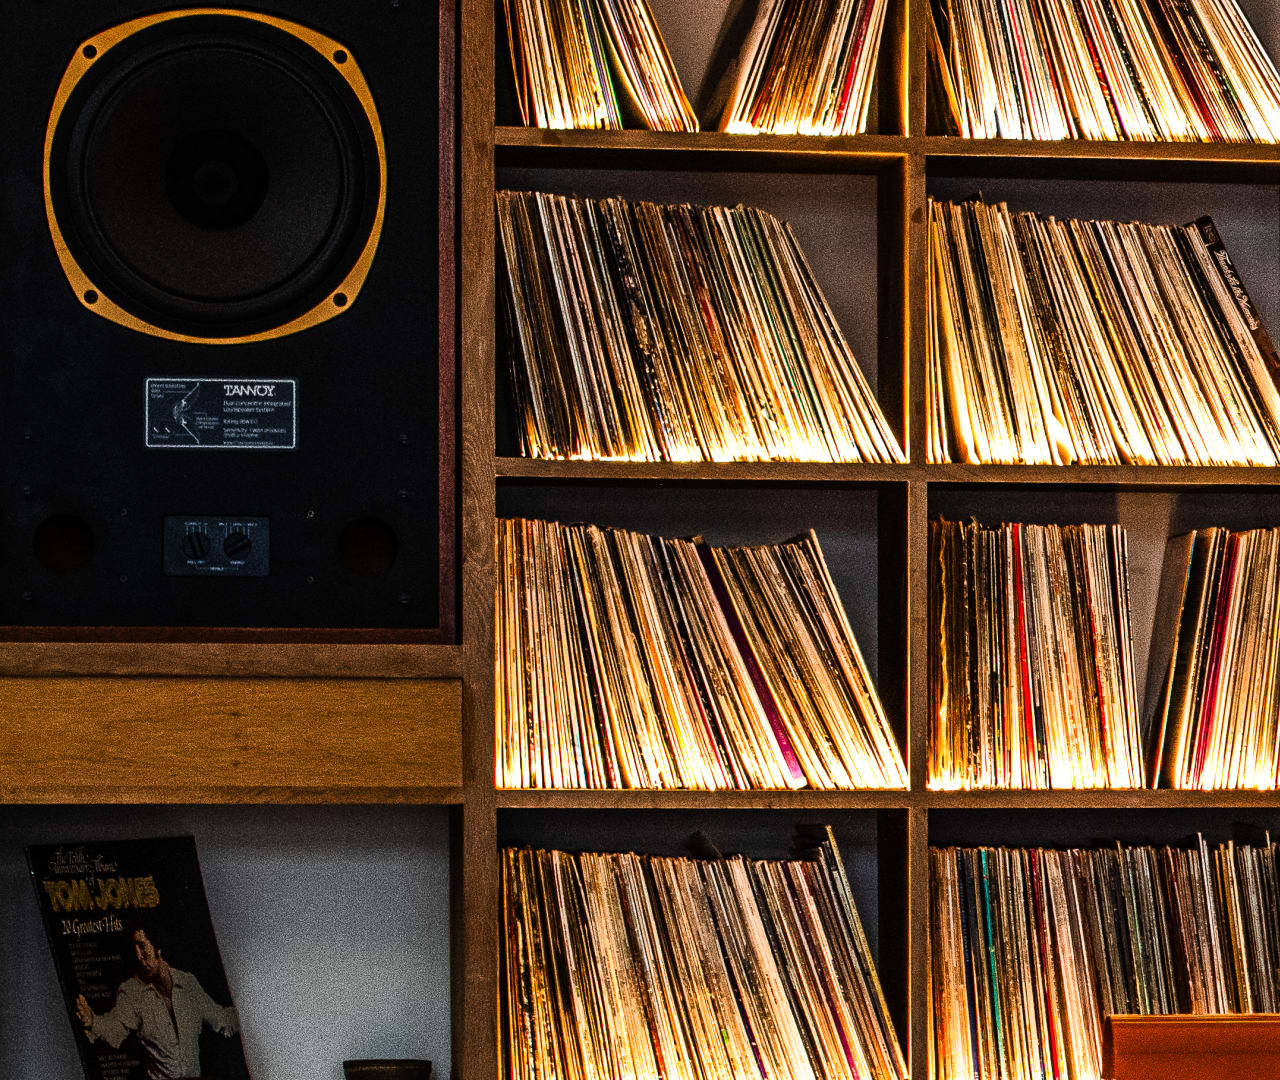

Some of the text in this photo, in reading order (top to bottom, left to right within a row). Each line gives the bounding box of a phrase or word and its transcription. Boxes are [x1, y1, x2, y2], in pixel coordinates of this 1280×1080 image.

[223, 385, 275, 397] TANNOY
[42, 875, 160, 912] TOM JONES
[102, 914, 124, 933] Hits
